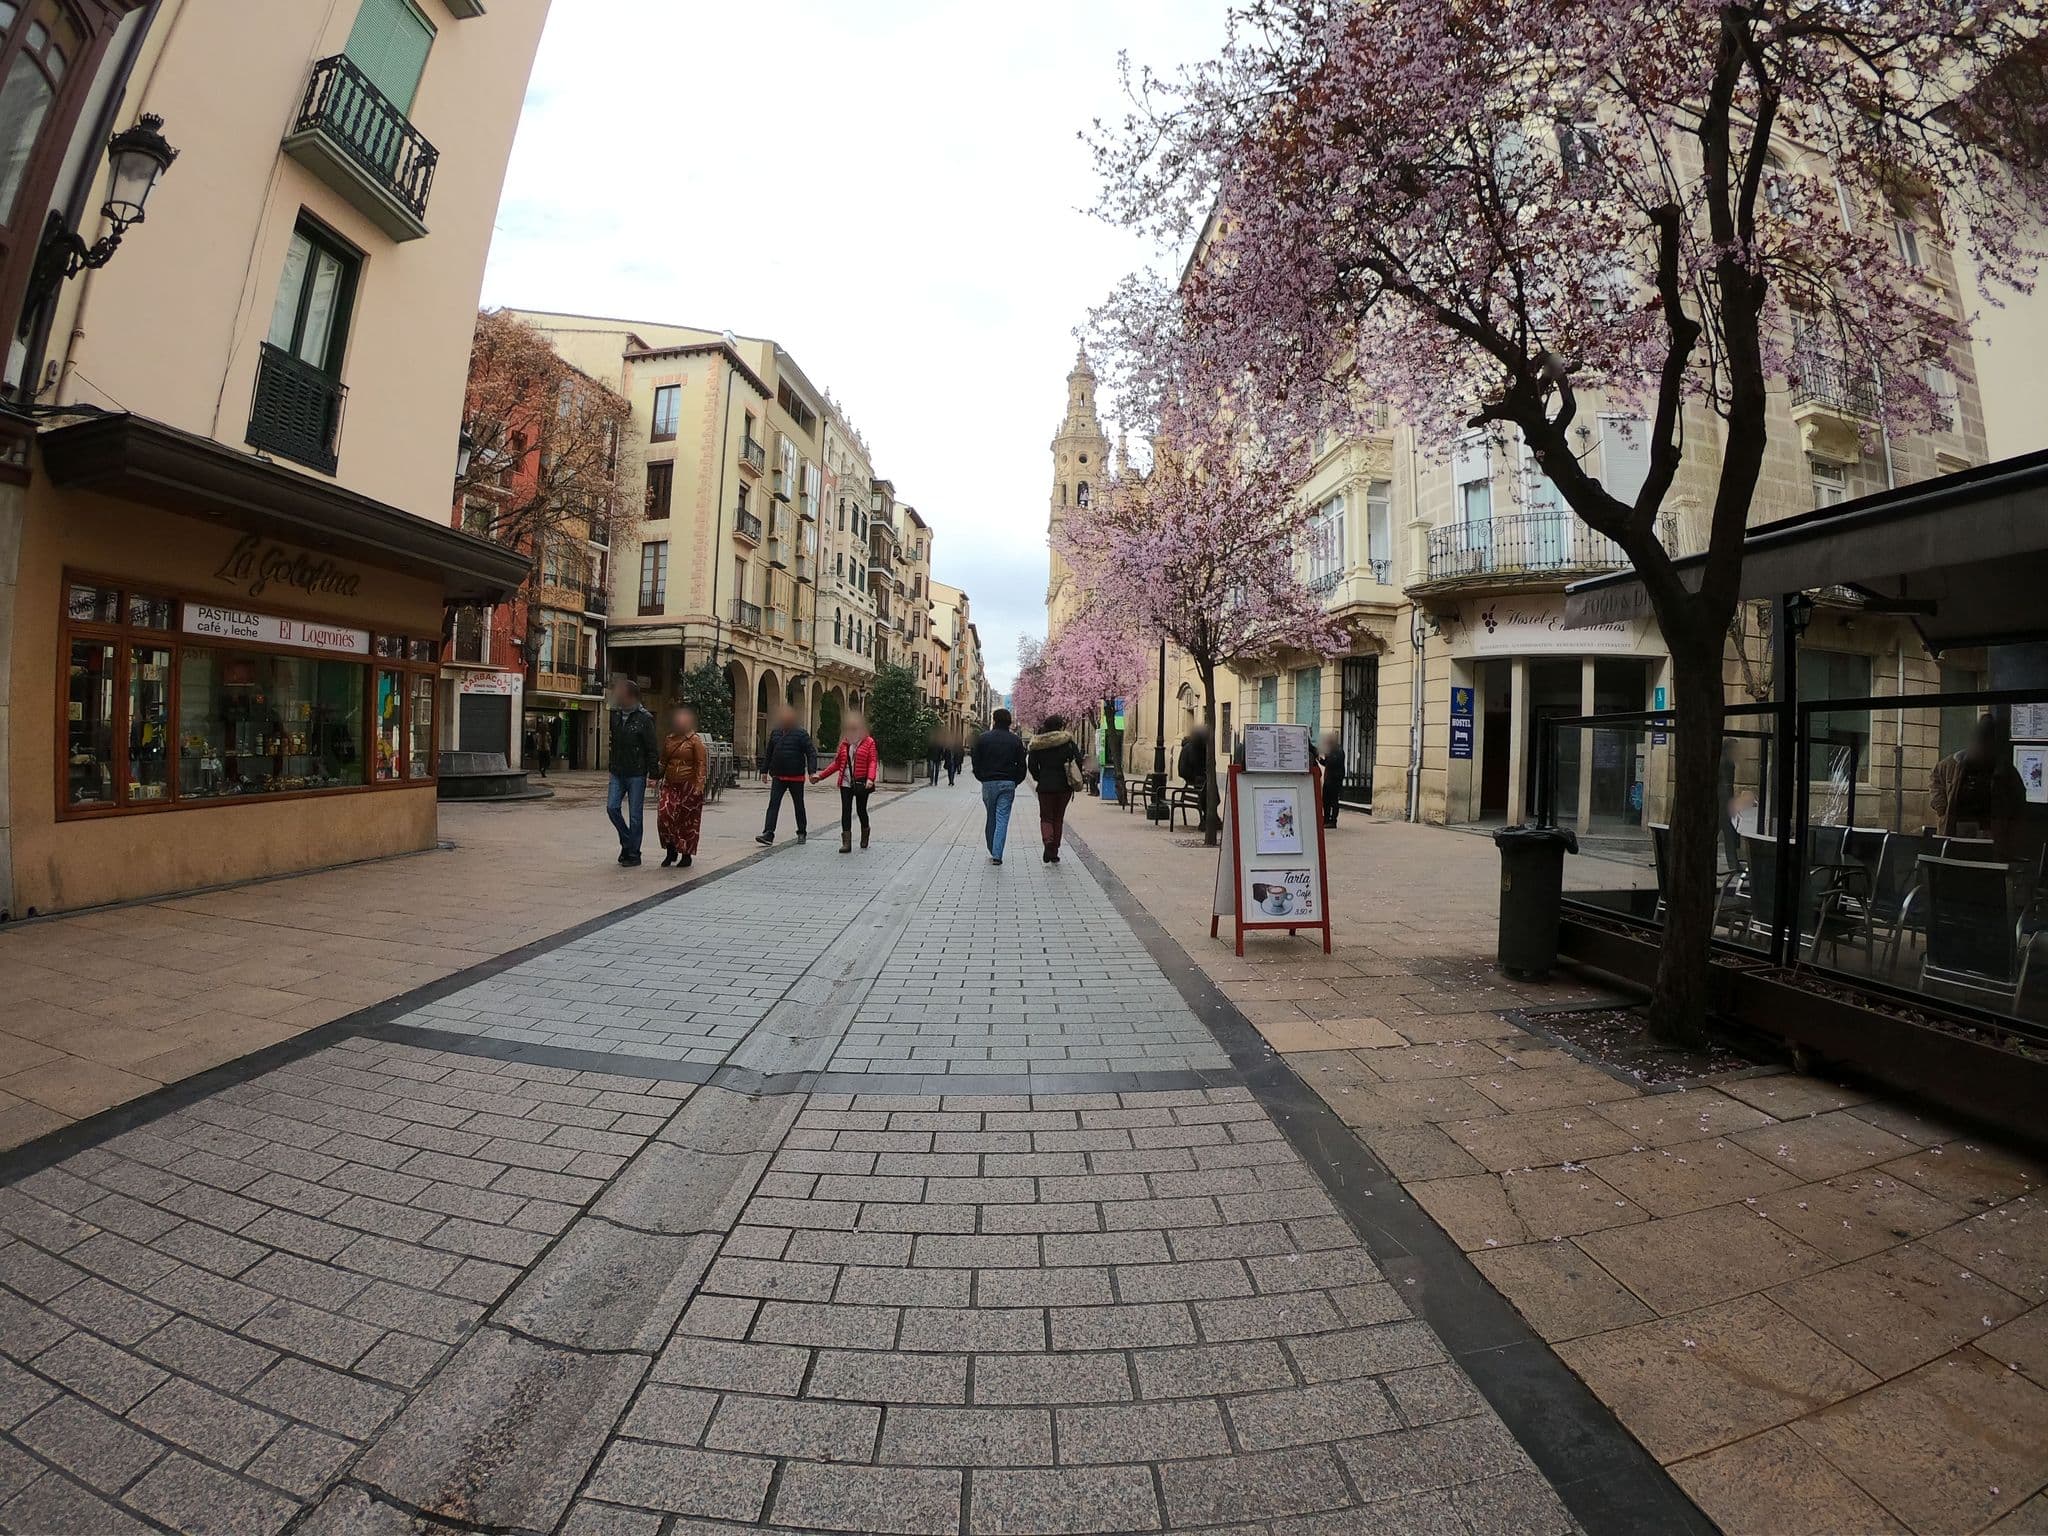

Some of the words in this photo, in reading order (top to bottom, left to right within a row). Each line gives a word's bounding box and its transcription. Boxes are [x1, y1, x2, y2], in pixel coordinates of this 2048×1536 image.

[198, 607, 260, 626] PASTILLAS
[1504, 608, 1548, 625] Hostel
[197, 620, 221, 634] café
[223, 627, 229, 636] y
[231, 624, 258, 638] leche
[279, 620, 292, 640] El
[302, 624, 355, 649] Logroñés
[463, 673, 507, 693] BARBACOA
[1452, 718, 1471, 727] HOSTEL
[1284, 871, 1310, 884] Tarta
[1296, 889, 1312, 900] Café
